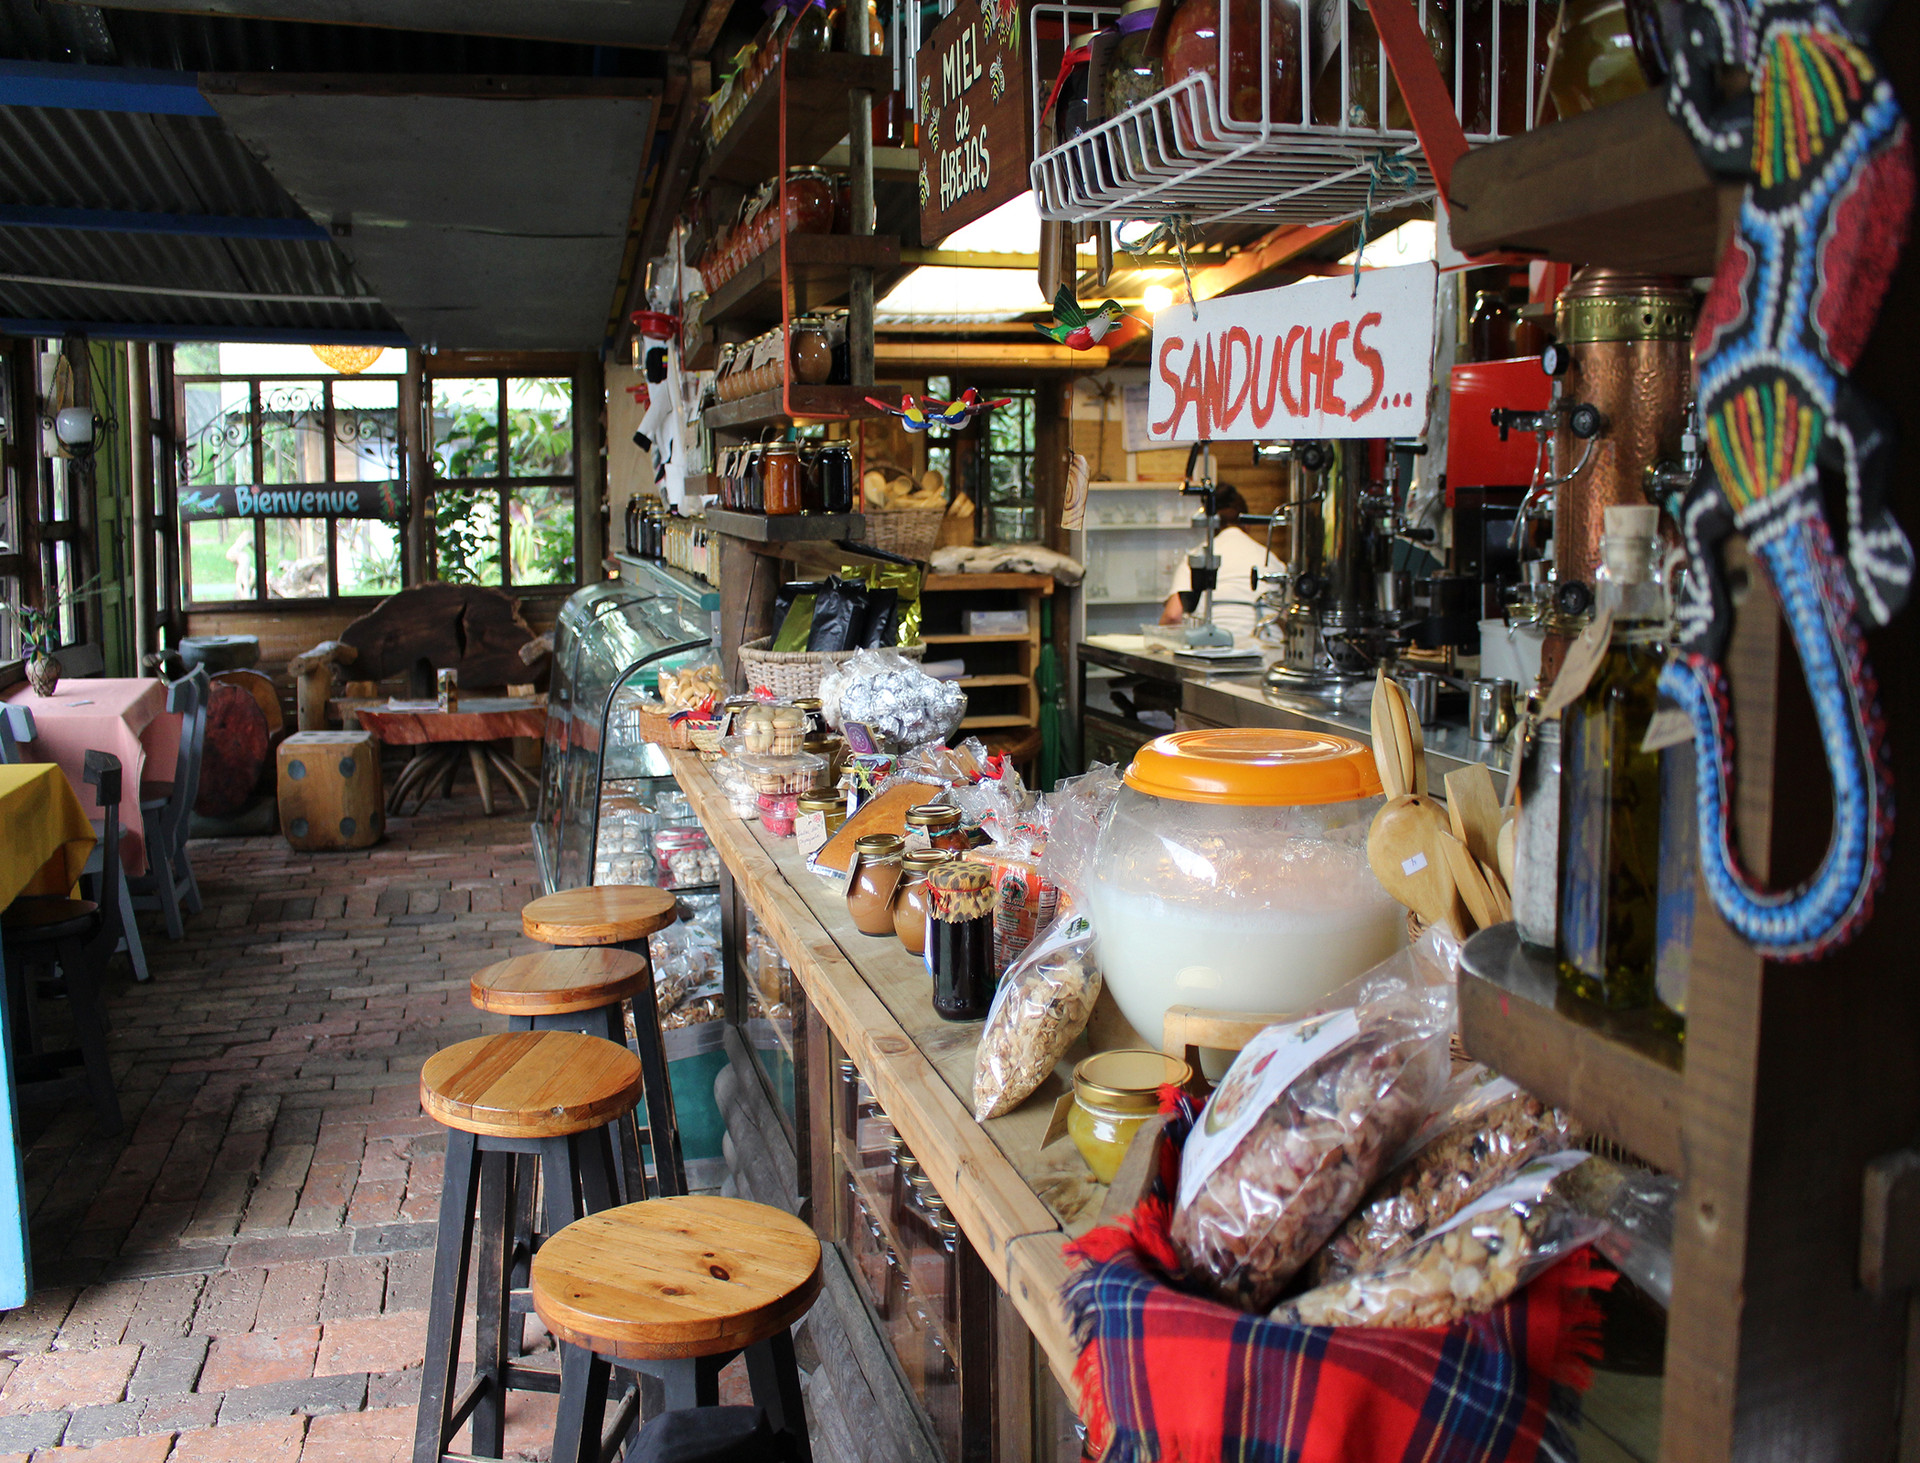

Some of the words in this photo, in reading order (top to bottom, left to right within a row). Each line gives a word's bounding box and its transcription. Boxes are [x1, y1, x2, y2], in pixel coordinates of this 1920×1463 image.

[942, 22, 983, 108] MIEL
[955, 97, 970, 142] de
[940, 123, 991, 212] ABEJAS
[1152, 311, 1413, 440] SANDUCHES...
[234, 485, 360, 516] Bienvenue
